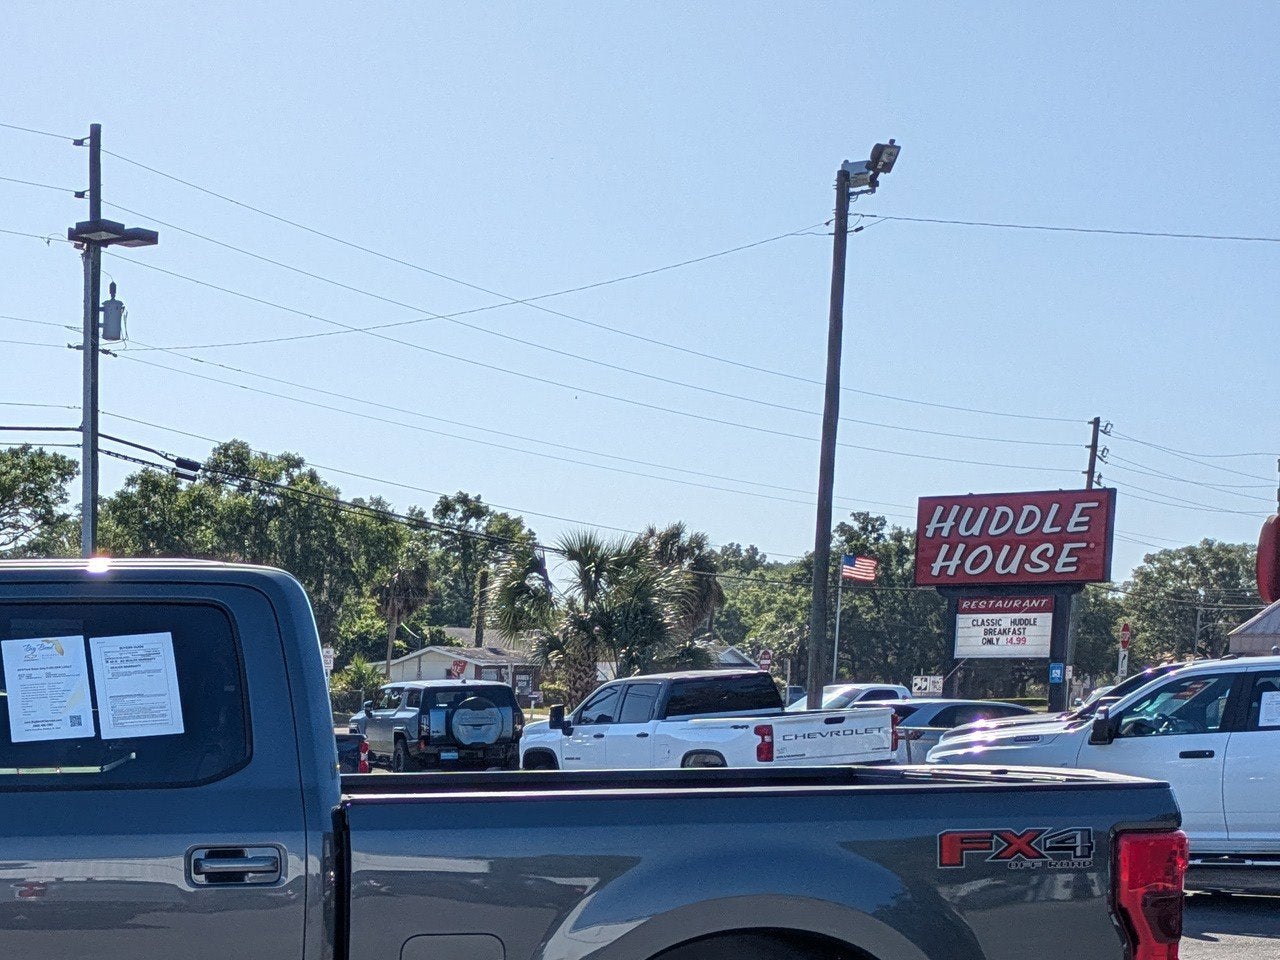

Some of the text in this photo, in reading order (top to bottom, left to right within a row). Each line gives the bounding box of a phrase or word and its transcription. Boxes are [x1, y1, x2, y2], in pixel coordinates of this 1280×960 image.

[925, 502, 1099, 538] HUDDLE
[931, 542, 1088, 576] HOUSE
[962, 599, 1048, 609] RESTAURANT
[972, 618, 1038, 627] CLASSIC HUDDLE
[983, 627, 1027, 636] BREAKFAST
[981, 637, 1027, 646] ONLY $4.99
[782, 726, 884, 741] CHEVROLET
[937, 827, 1096, 869] FX4
[1008, 860, 1094, 869] OFF ROAD
